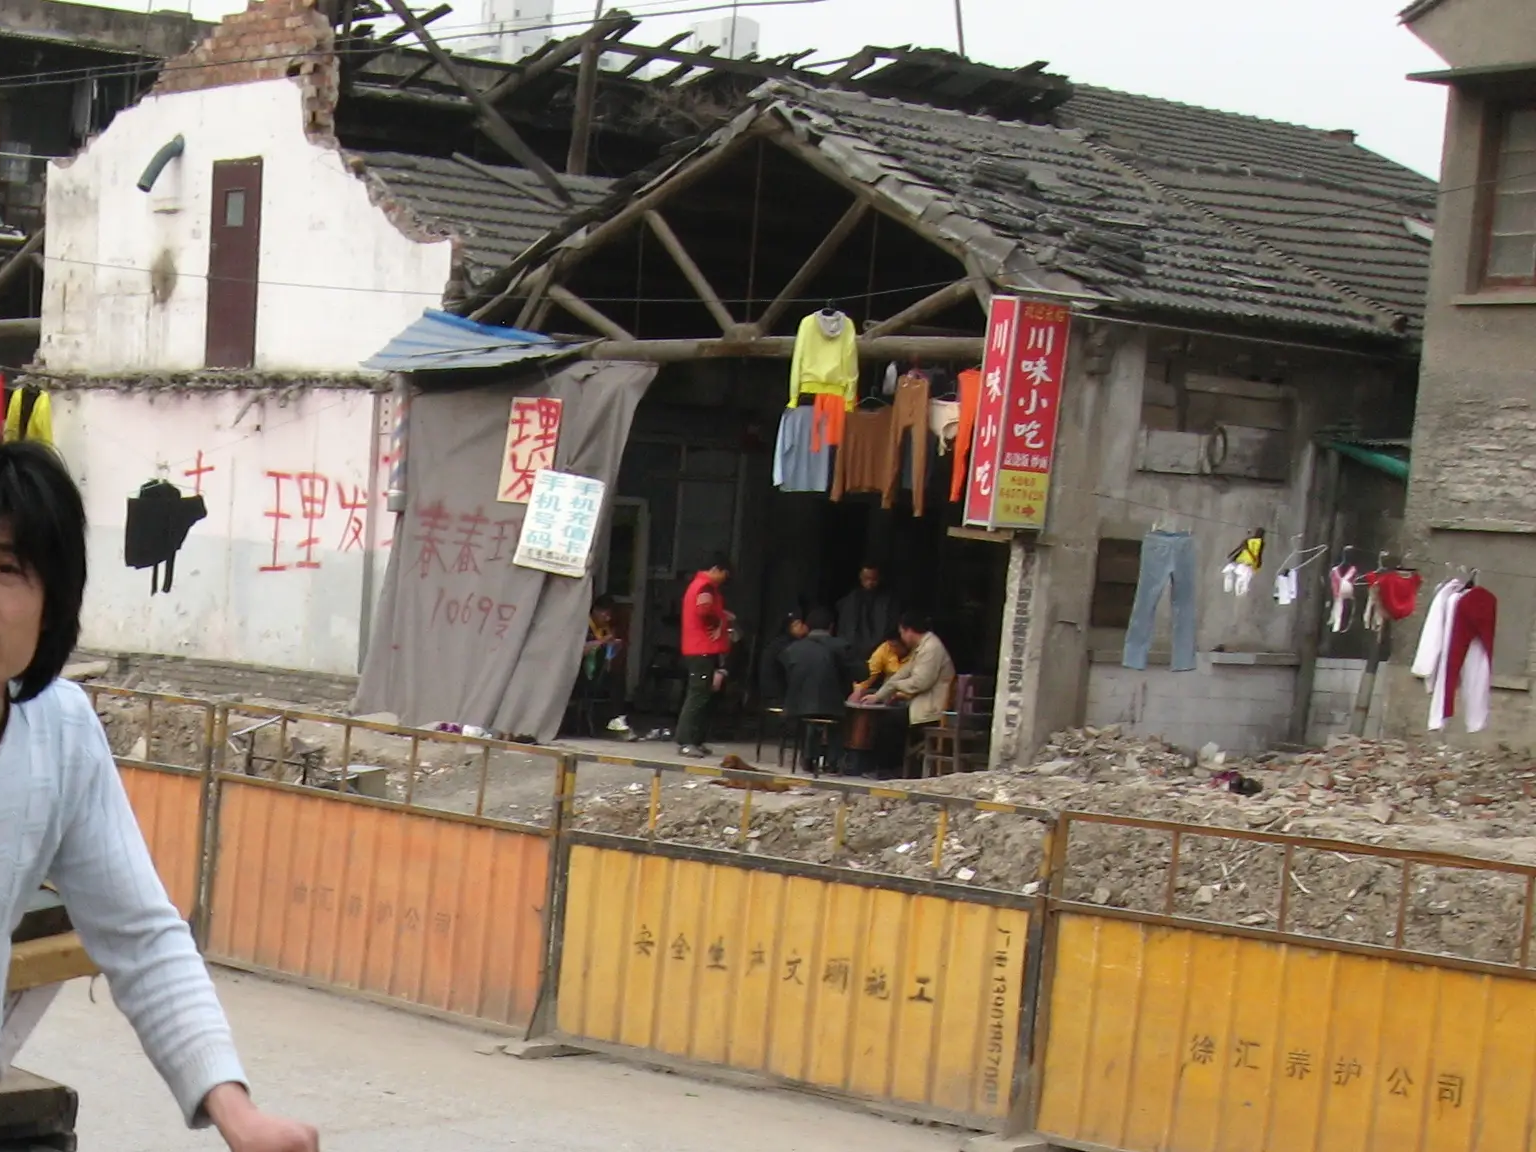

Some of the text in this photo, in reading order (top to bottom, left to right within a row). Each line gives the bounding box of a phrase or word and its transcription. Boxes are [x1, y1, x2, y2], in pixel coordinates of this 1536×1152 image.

[975, 319, 1009, 496] 川味小吃
[1011, 325, 1055, 449] 川味小吃
[259, 471, 369, 572] 理发
[525, 470, 569, 549] 手机号码
[560, 478, 604, 554] 手机充值卡
[430, 588, 517, 638] 1069号
[633, 923, 934, 1004] 安全生产文明施工
[1189, 1033, 1464, 1109] 徐汇养护公司
